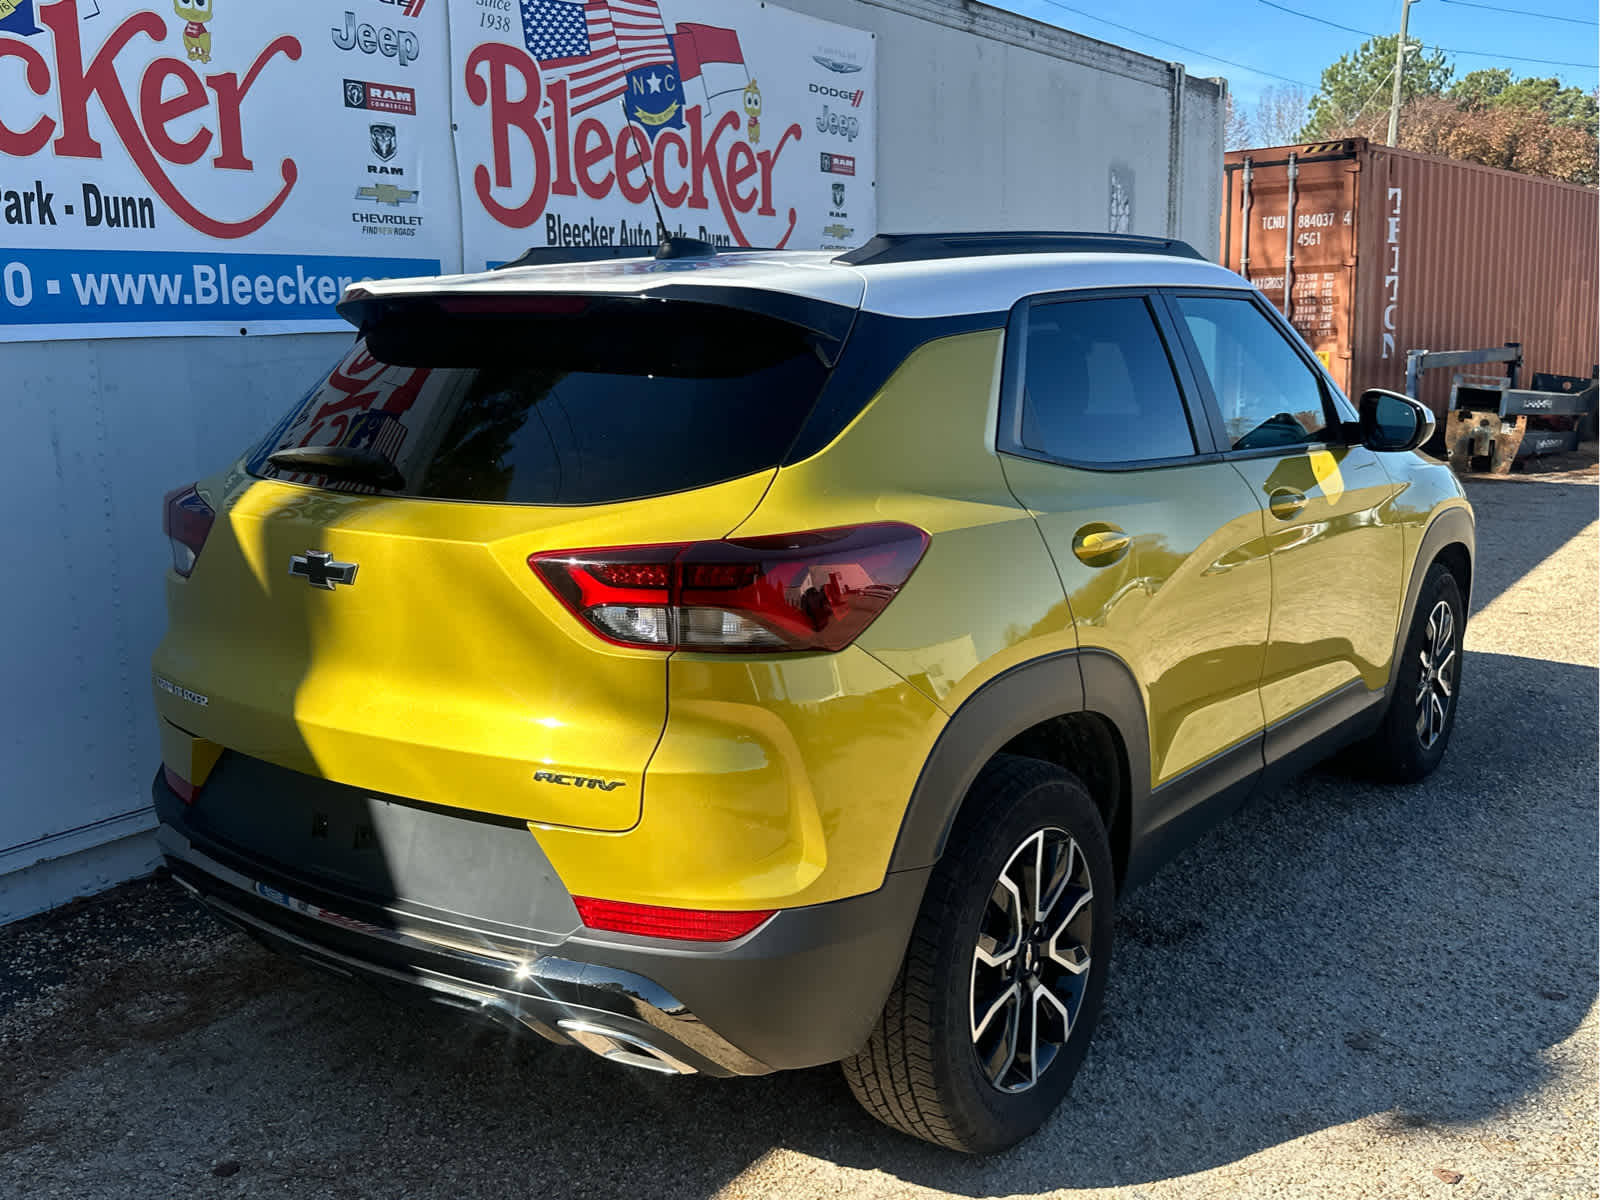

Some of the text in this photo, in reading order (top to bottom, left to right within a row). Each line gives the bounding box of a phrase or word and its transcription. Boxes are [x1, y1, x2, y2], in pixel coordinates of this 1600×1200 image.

[480, 12, 511, 33] 1938
[331, 11, 419, 67] Jeep
[370, 88, 411, 102] RAM
[632, 74, 676, 95] N C
[809, 83, 856, 101] DODGE
[816, 104, 859, 142] Jeep
[465, 42, 802, 249] Bleecker
[367, 165, 404, 176] RAM
[0, 180, 156, 229] ark Dunn
[352, 212, 423, 226] CHEVROLET
[1262, 210, 1352, 230] TCNU 884037 4
[546, 213, 730, 247] Bleecker Auto Prk Dunn
[1297, 231, 1321, 247] 45G1
[71, 263, 392, 306] www.Bleecker
[533, 770, 626, 791] ACTIV
